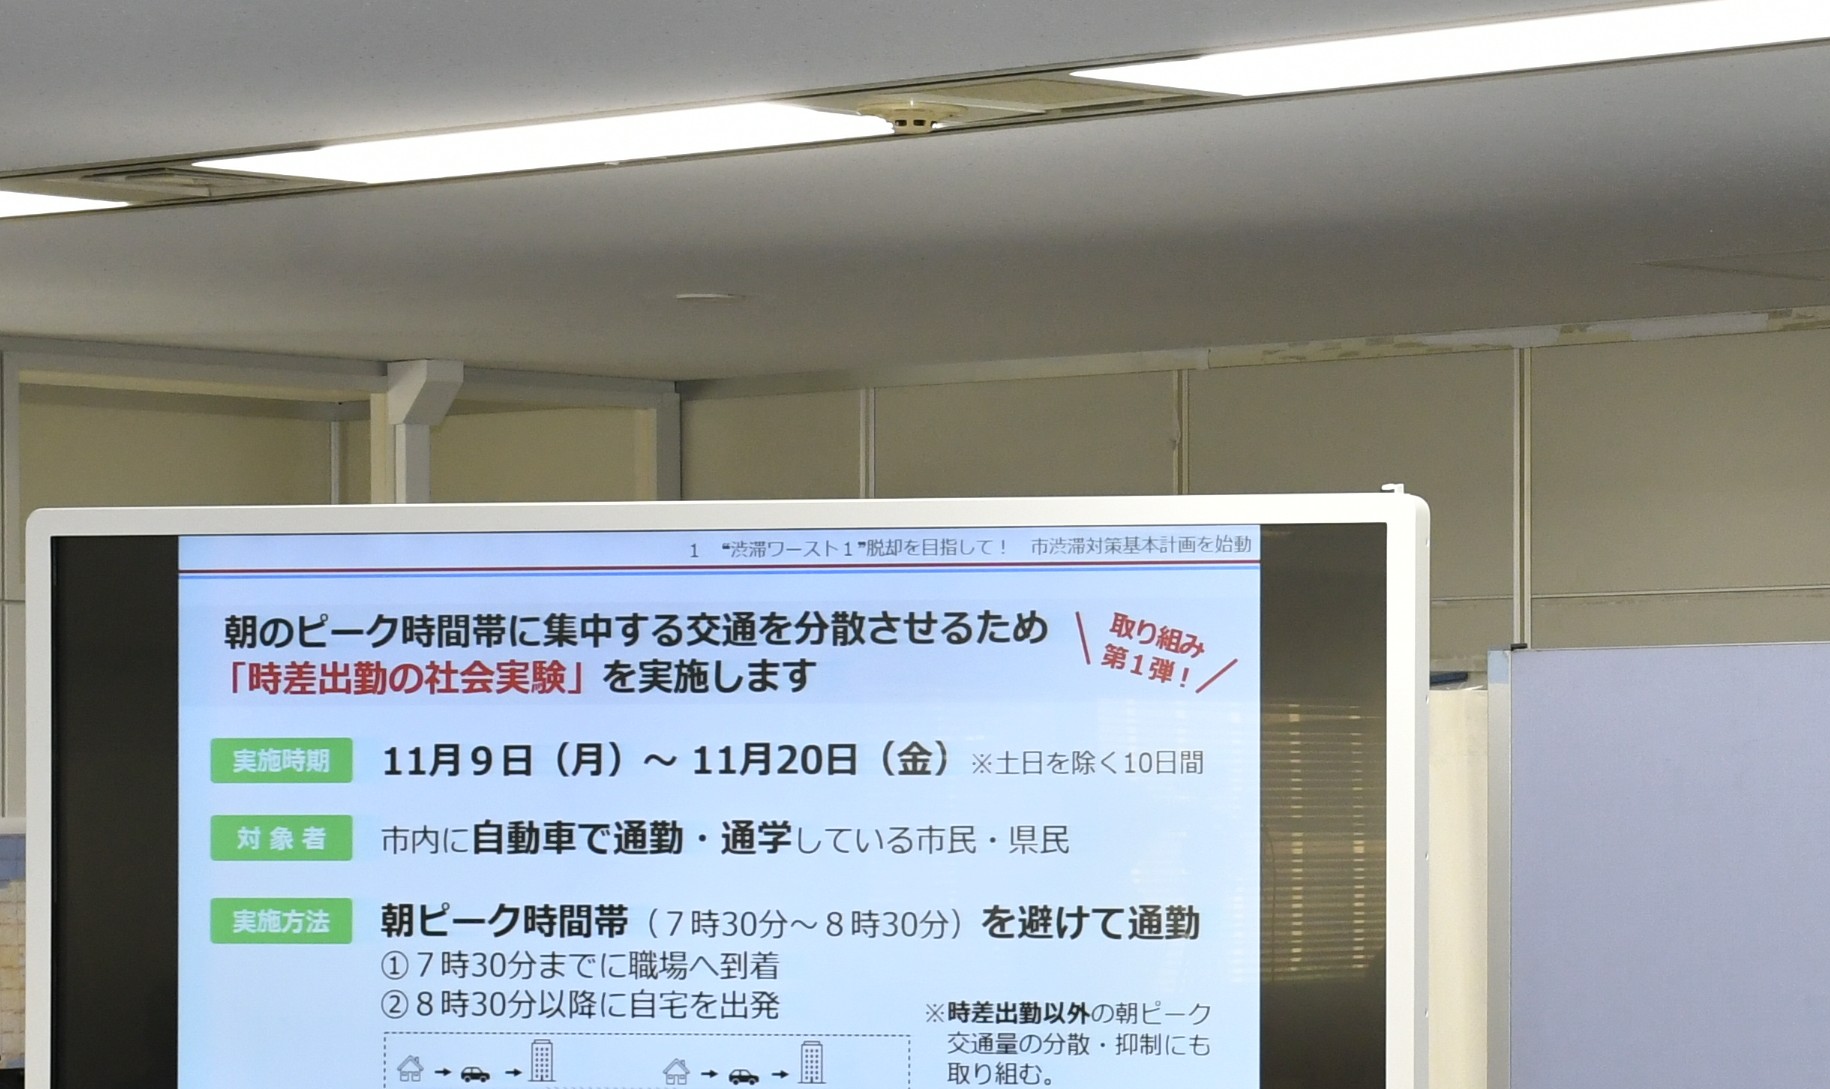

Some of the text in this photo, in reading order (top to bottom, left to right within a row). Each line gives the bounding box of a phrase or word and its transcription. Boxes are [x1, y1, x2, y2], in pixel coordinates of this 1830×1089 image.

[691, 544, 698, 557] 1
[1032, 535, 1251, 555] 市渋滞対策基本計画を始動
[225, 610, 1047, 649] 朝のピーク時間帯に集中する交通を分散させるため
[1110, 612, 1206, 658] 取り組み
[233, 659, 816, 695] 「時差出勤の社会実験」を実施します
[1101, 644, 1191, 688] 第1弾！
[233, 749, 330, 773] 実施時期
[695, 741, 946, 776] 11月20日（金）
[973, 751, 1203, 775] ※土日を除く10日間
[237, 827, 326, 850] 対象者
[382, 819, 1068, 854] 市内に自動車で通勤・通学している市民・県民
[233, 909, 330, 934] 実施方法
[381, 950, 779, 980] ①7時30分までに職場へ到着
[381, 989, 779, 1019] ②8時30分以降に自宅を出発
[927, 1001, 1210, 1024] ※時差出勤以外の朝ピーク
[948, 1031, 1209, 1055] 交通量の分散・抑制にも
[948, 1062, 1051, 1085] 取り組む。
